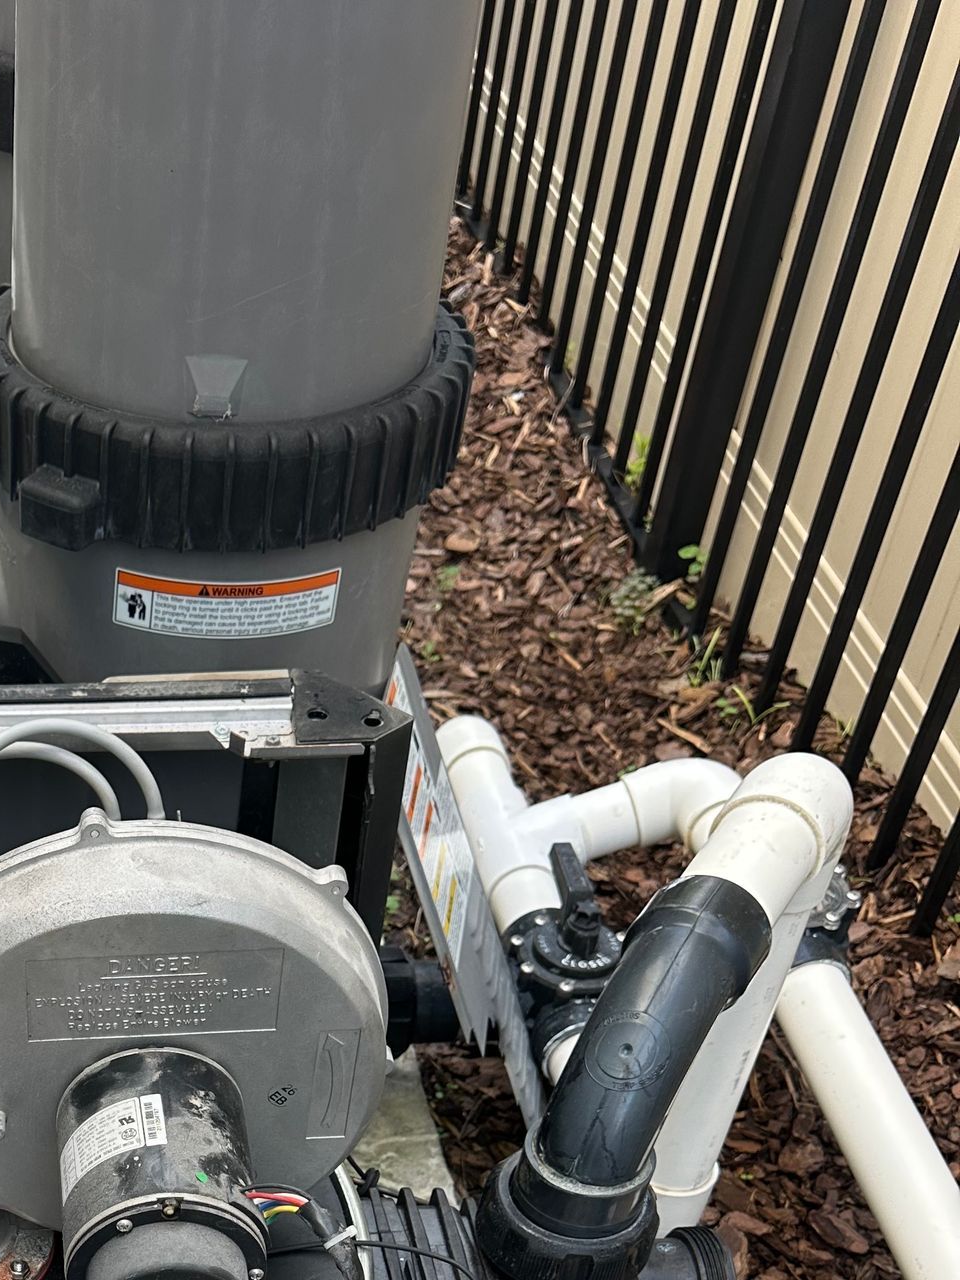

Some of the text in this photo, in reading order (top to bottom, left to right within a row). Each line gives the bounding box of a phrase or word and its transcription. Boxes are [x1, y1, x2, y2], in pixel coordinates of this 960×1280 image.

[212, 586, 264, 596] WARNING
[161, 609, 187, 618] properly
[173, 619, 203, 627] damaged
[108, 955, 201, 974] DANGER!
[79, 977, 229, 993] Leaking GAS can cause
[35, 995, 102, 1008] EXPLOSION
[120, 992, 166, 1004] SEVERE
[174, 990, 213, 1001] INJURY
[232, 987, 272, 999] DEATH
[68, 1009, 84, 1020] DO
[88, 1007, 112, 1018] NOT
[163, 1017, 207, 1028] Blower
[281, 1083, 297, 1096] 26
[269, 1091, 288, 1106] EB
